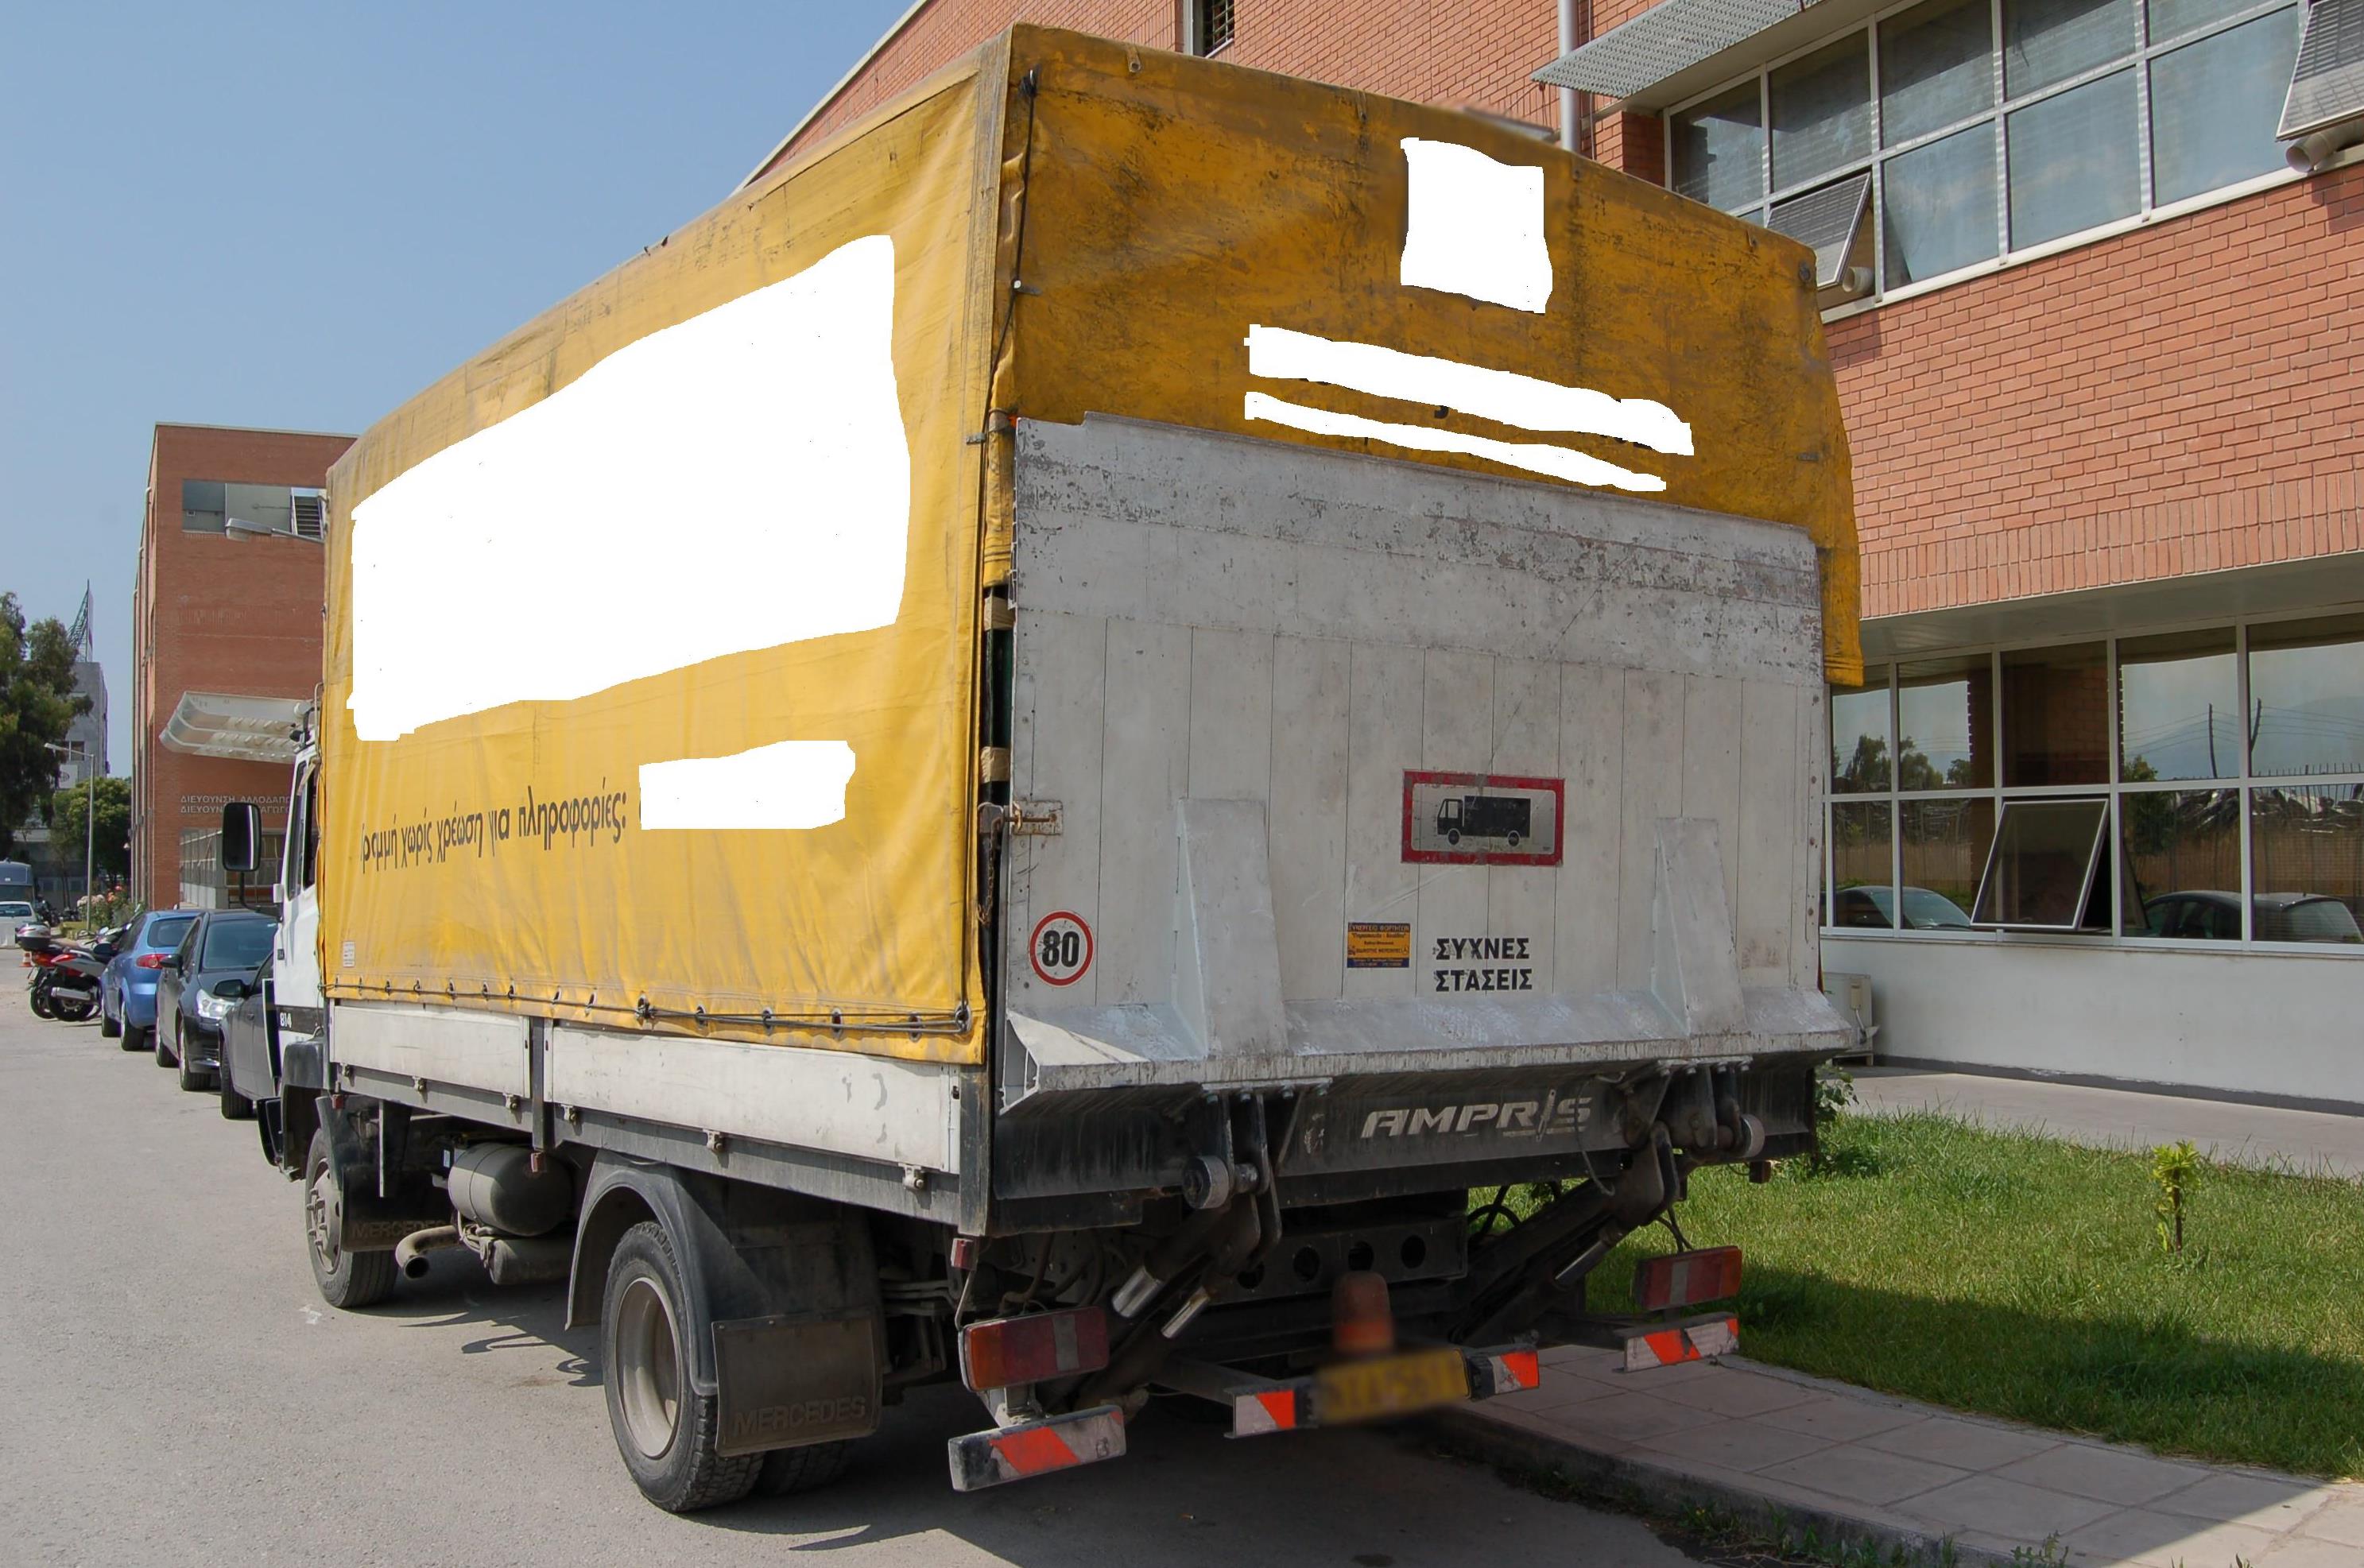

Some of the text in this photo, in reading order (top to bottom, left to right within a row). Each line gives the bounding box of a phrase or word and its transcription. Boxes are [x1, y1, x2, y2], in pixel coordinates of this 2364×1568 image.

[401, 807, 432, 868] χωρίς
[436, 800, 483, 863] χρέωση
[487, 807, 510, 858] για
[518, 776, 627, 852] πληροφορίες:
[1042, 930, 1079, 967] 80
[1435, 938, 1529, 960] ΣΥΧΝΕΣ
[1435, 968, 1533, 992] ΣΤΑΣΕΙΣ
[279, 1012, 293, 1028] 814
[1360, 1097, 1592, 1138] AMPRS
[733, 1396, 866, 1437] MERCEDES
